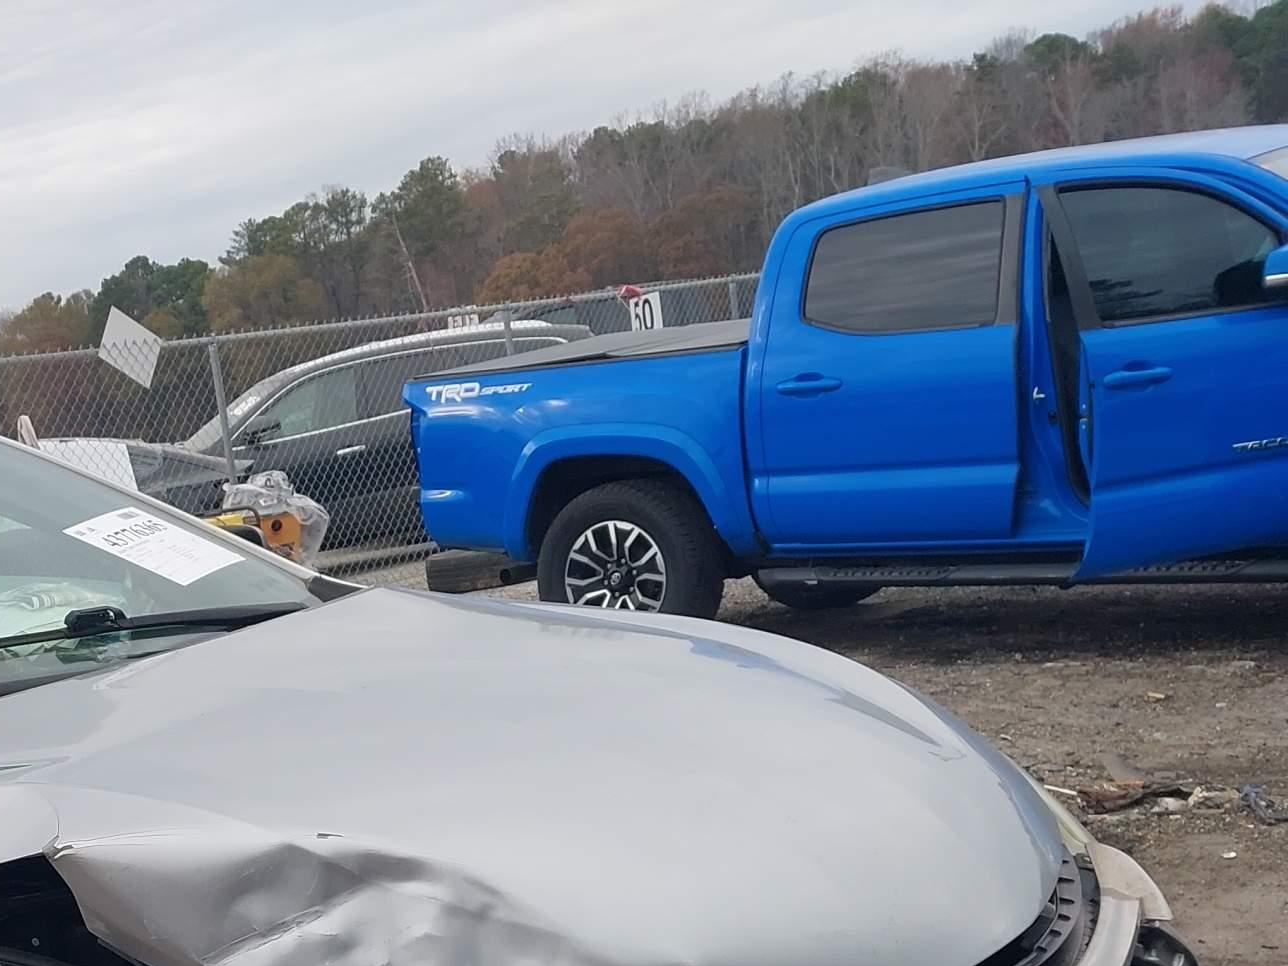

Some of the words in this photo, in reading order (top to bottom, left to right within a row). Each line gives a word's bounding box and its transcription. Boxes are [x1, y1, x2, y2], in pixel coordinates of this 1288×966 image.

[633, 297, 655, 330] 50
[425, 382, 480, 403] TRD
[480, 383, 533, 396] SPORT
[101, 519, 169, 549] 43776365
